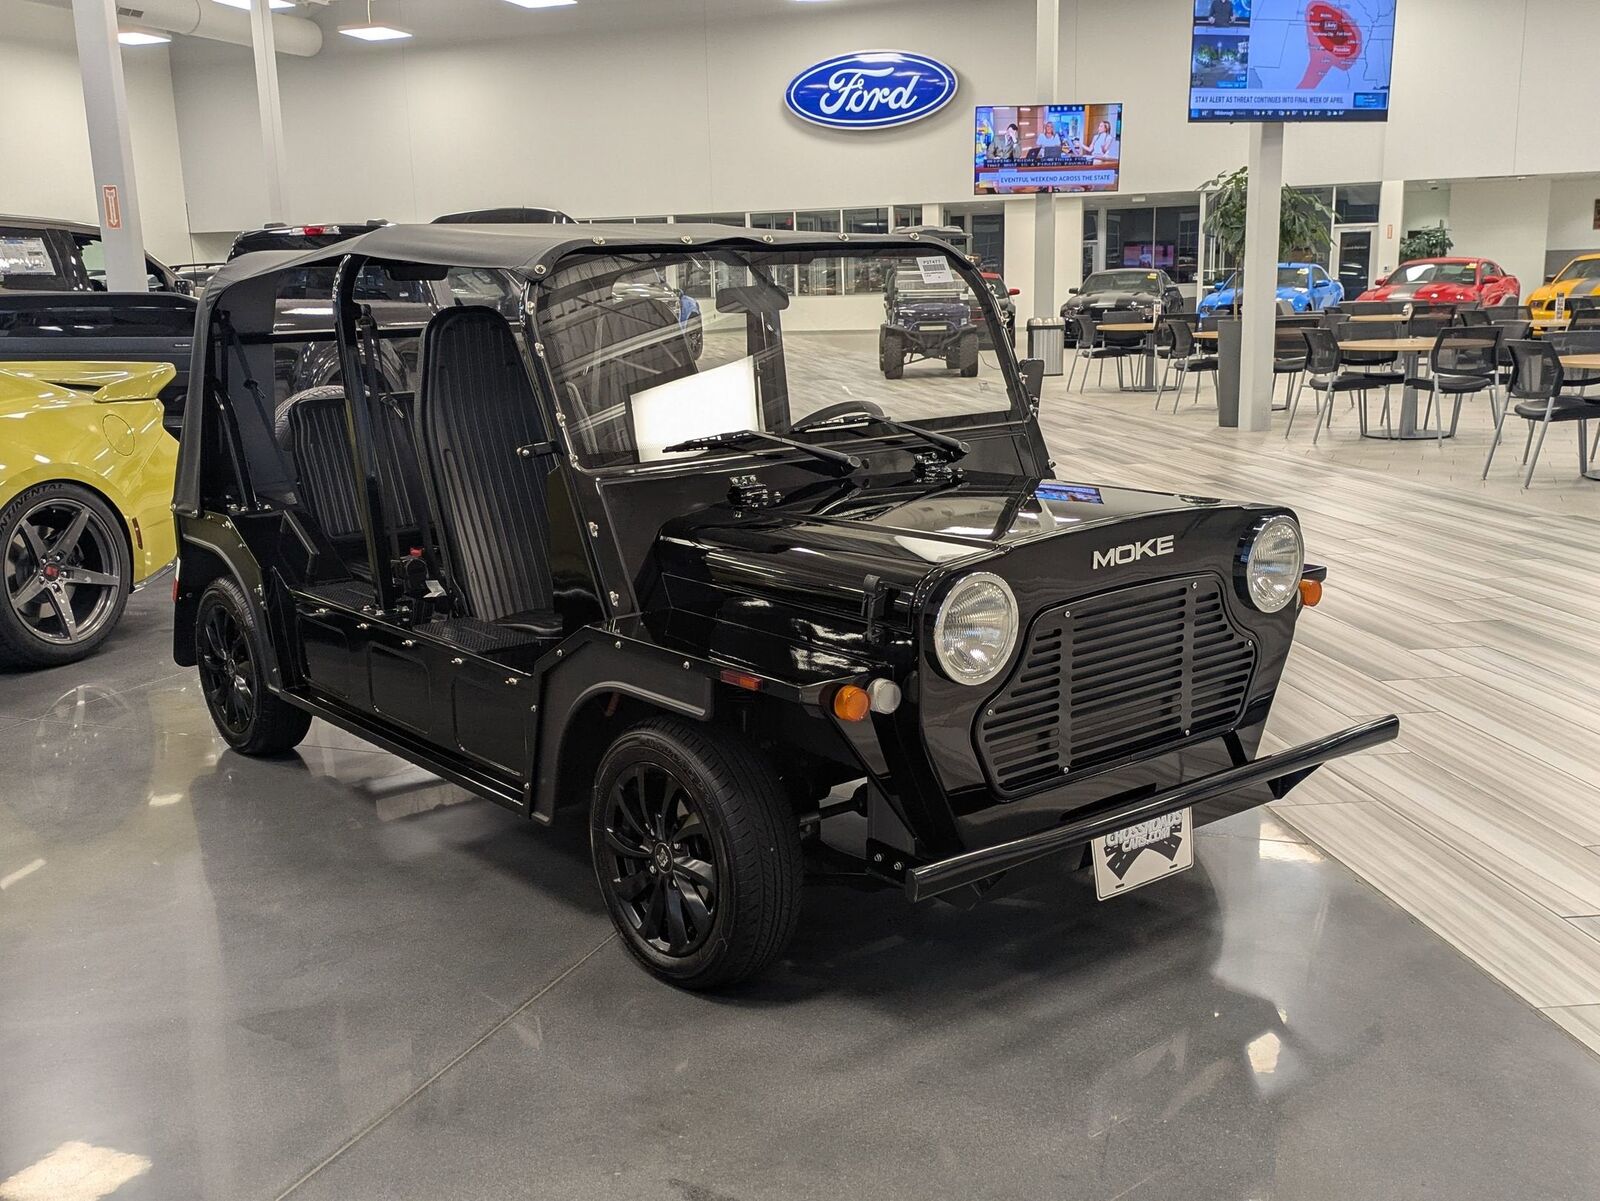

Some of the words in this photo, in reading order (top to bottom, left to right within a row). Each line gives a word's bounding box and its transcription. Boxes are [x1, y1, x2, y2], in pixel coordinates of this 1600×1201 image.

[819, 66, 921, 115] Ford
[1195, 95, 1208, 104] STAY
[1209, 95, 1225, 104] ALERT
[1226, 95, 1233, 104] AS
[1234, 95, 1253, 104] THREAT
[1254, 95, 1281, 104] CONTINUES
[1281, 96, 1293, 104] INTO
[1295, 96, 1308, 104] FINAL
[1309, 96, 1323, 104] WEEK
[1323, 96, 1330, 104] OF
[1330, 96, 1344, 104] APRIL
[1000, 176, 1029, 184] EVENTFUL
[1030, 175, 1058, 183] WEEKEND
[1092, 534, 1175, 570] MOKE
